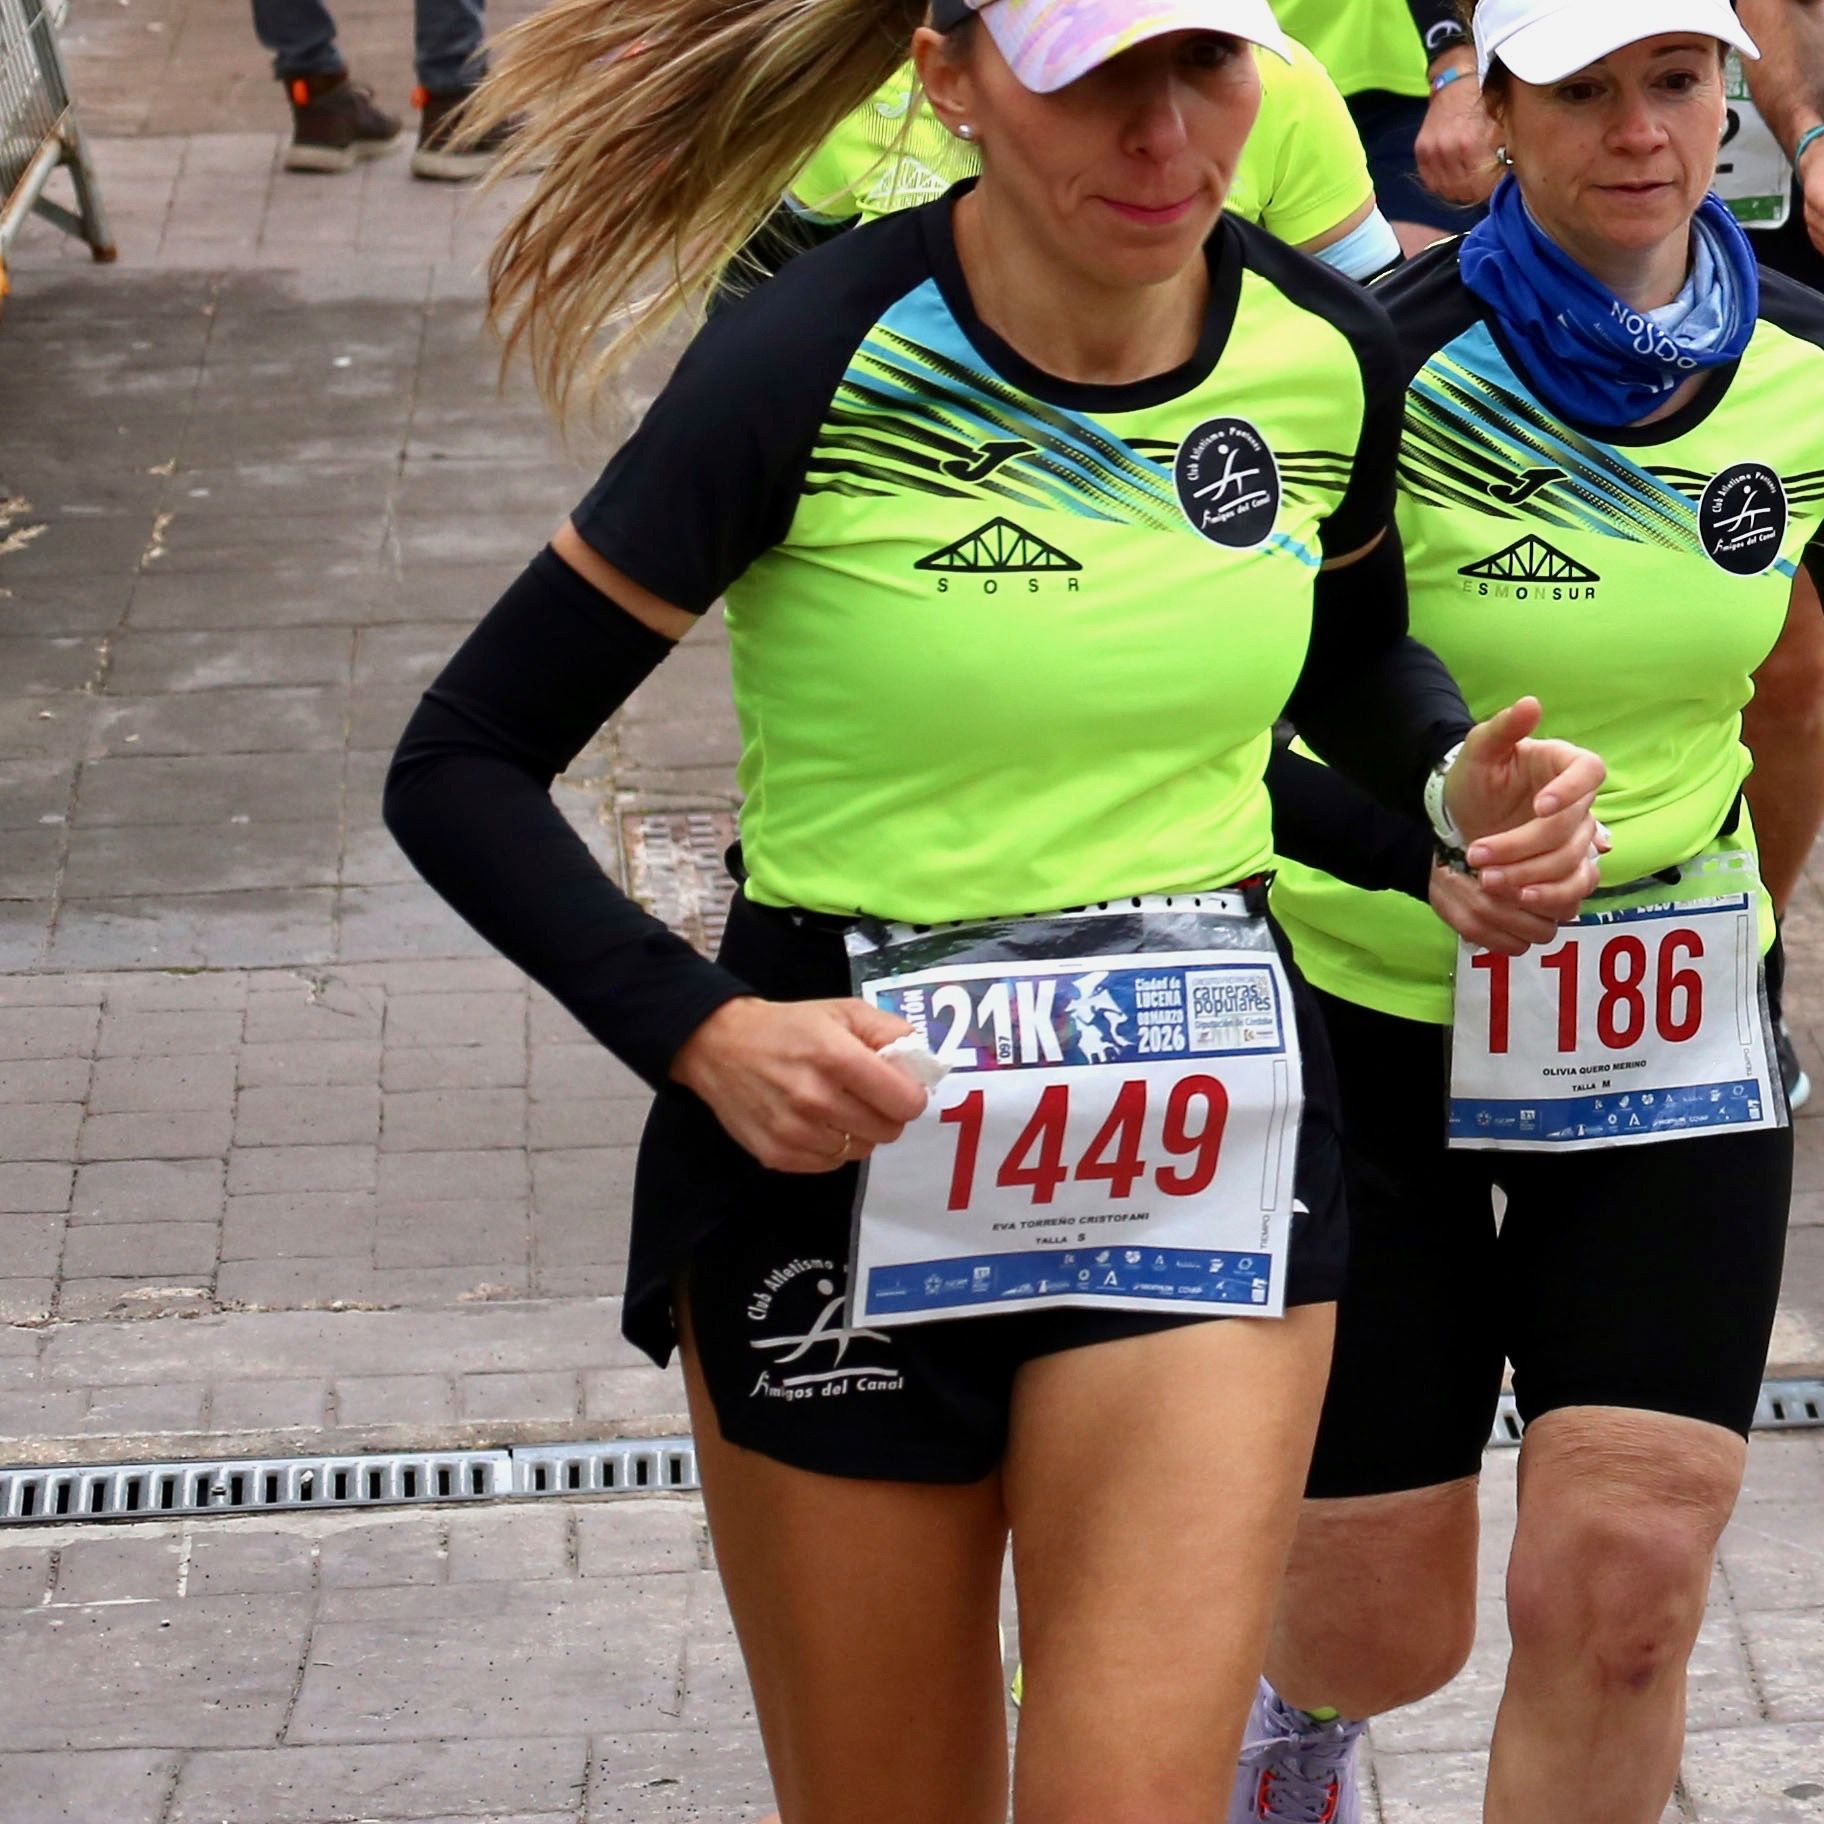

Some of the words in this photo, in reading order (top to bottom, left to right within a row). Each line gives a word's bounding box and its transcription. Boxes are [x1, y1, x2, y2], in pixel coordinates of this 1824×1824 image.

[1237, 505, 1249, 514] del
[1747, 535, 1757, 546] del
[1135, 978, 1167, 991] Ciudad
[1169, 978, 1181, 990] de
[1193, 984, 1257, 1000] carreras
[1471, 928, 1705, 1054] 1186
[1135, 991, 1182, 1008] LUCENA
[1193, 997, 1271, 1017] populares
[932, 980, 1064, 1068] 21K
[998, 1035, 1012, 1060] 097
[1138, 1027, 1185, 1054] 2026
[1542, 1066, 1577, 1077] OLIVIA
[1579, 1064, 1611, 1075] QUERO
[1613, 1059, 1647, 1071] MERINO
[1572, 1082, 1597, 1092] TALLA
[1601, 1079, 1611, 1089] M
[939, 1074, 1230, 1211] 1449
[992, 1222, 1017, 1231] EVA
[1020, 1217, 1076, 1230] TORREÑO
[1079, 1212, 1150, 1225] CRISTOFANI
[1036, 1236, 1068, 1245] TALLA
[1077, 1233, 1086, 1242] S
[1261, 1215, 1270, 1250] TIEMPO
[747, 1290, 772, 1322] Club
[768, 1259, 834, 1293] Atletismo
[821, 1380, 848, 1397] del
[856, 1375, 904, 1391] Canal
